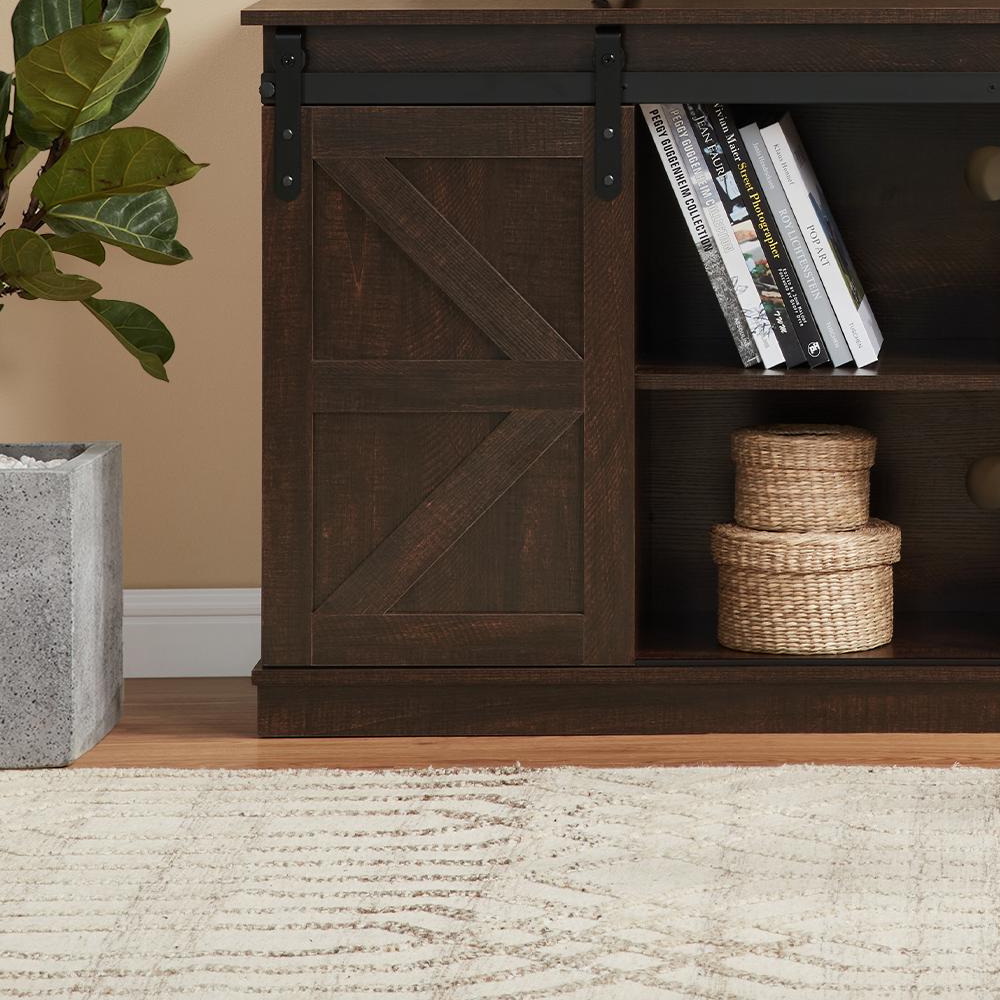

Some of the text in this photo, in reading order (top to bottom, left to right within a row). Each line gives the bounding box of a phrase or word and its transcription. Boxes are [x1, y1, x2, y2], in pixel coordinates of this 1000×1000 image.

[648, 108, 714, 252] PEGGY GUGGENHEIM COLLECTION
[668, 108, 688, 138] PEGGY
[679, 138, 713, 198] GUGGENHEIM
[691, 112, 729, 181] JEAN FAUR
[711, 101, 784, 261] Vivian Maier Street Photographer
[772, 143, 785, 161] Klaus
[777, 207, 822, 300] ROY LICHTENSTEIN
[806, 224, 830, 267] POP ART
